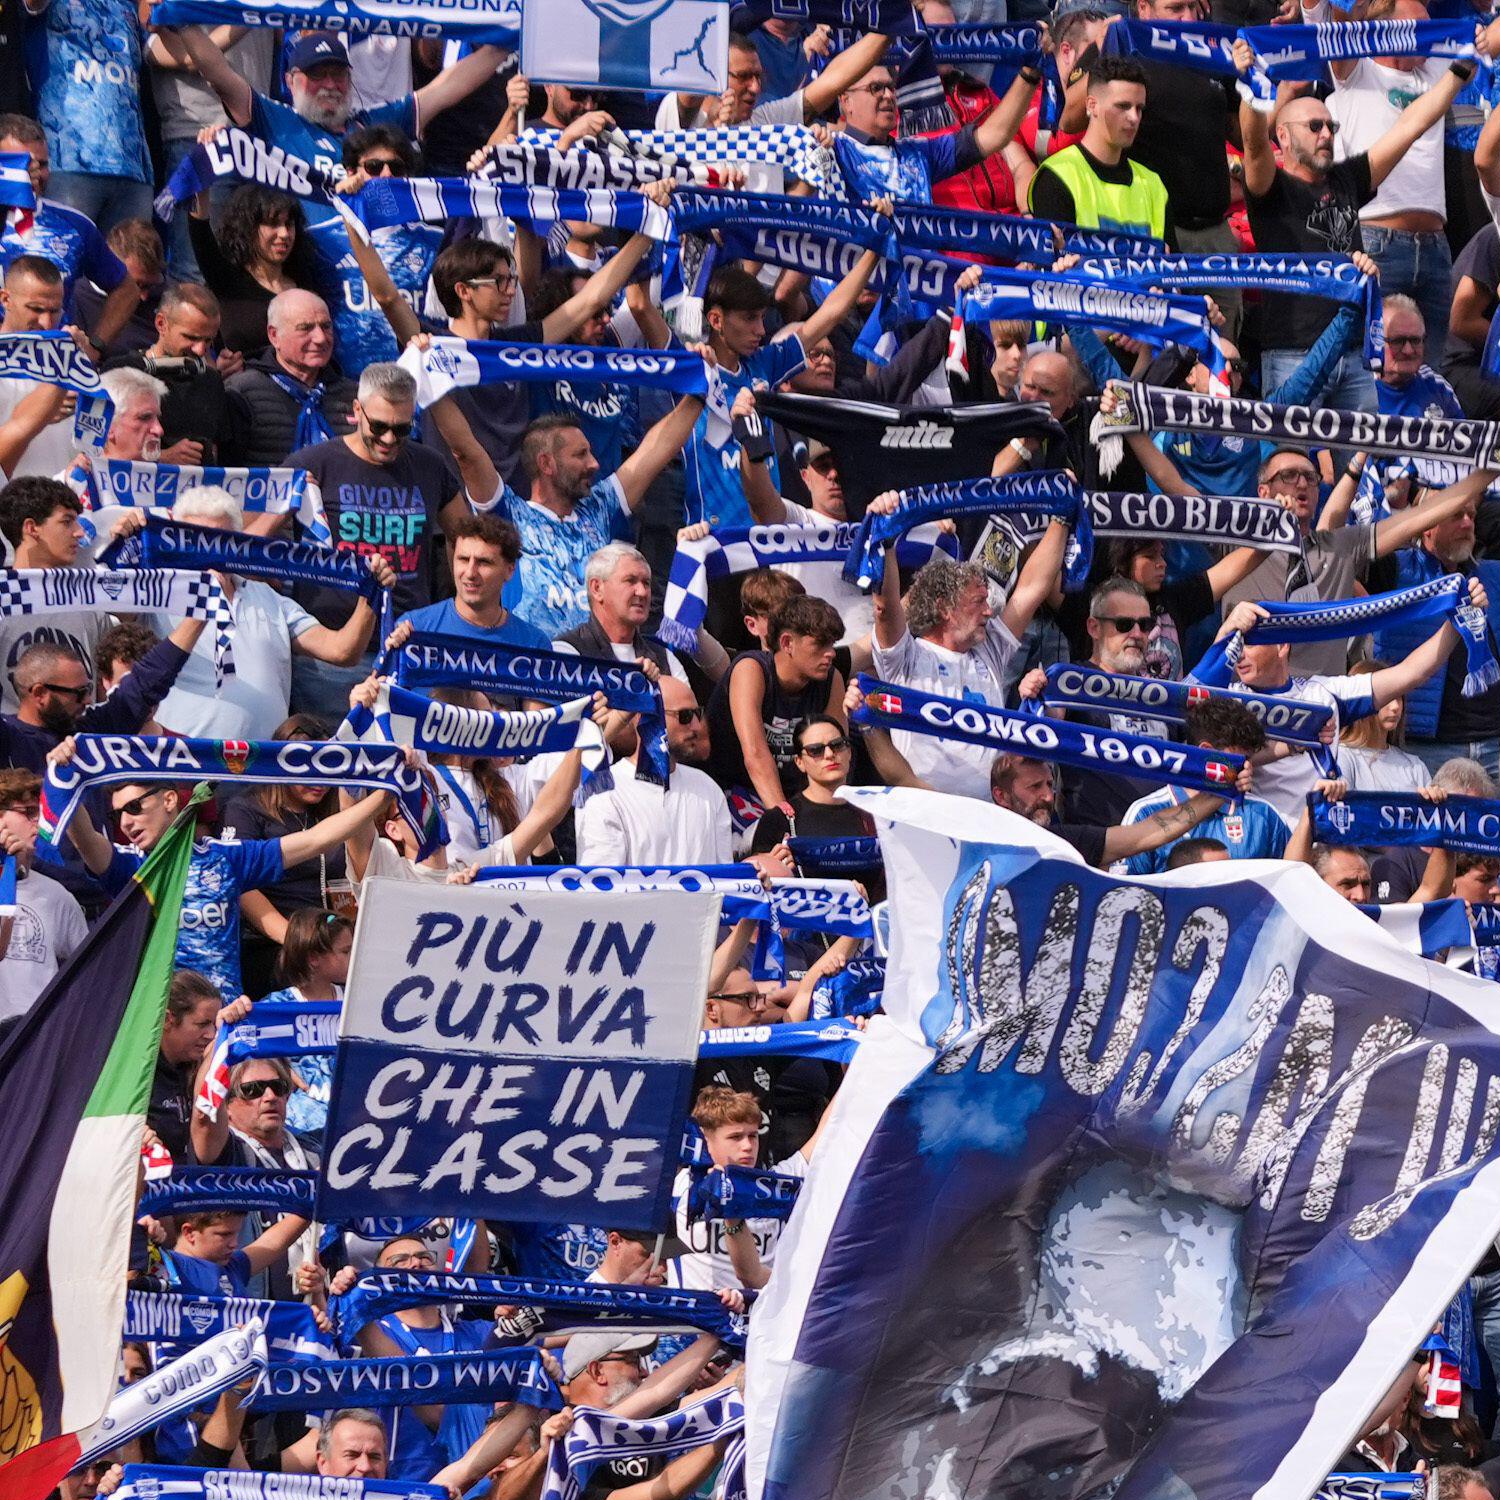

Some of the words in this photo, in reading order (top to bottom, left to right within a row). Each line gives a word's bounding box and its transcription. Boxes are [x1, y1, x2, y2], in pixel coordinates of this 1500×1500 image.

[205, 128, 312, 195] COMO
[1031, 282, 1082, 313] SEMM
[1081, 288, 1168, 325] CUMASCH
[500, 347, 594, 370] COMO
[606, 353, 676, 375] 1907
[882, 420, 953, 449] mita
[1168, 394, 1269, 437] LET'S
[1283, 405, 1340, 440] GO
[1357, 411, 1474, 454] BLUES
[339, 485, 424, 509] GIVOVA
[1120, 492, 1174, 527] GO
[1181, 497, 1296, 541] BLUES
[159, 525, 252, 556] SEMM
[339, 512, 425, 543] SURF
[748, 524, 833, 553] COMO
[405, 644, 500, 675] SEMM
[1056, 670, 1168, 704] COMO
[421, 702, 492, 745] COMO
[500, 710, 552, 746] 1907
[919, 700, 1059, 748] COMO
[1079, 733, 1187, 773] 1907
[48, 736, 201, 787] CURVA
[276, 741, 422, 791] COMO
[1379, 805, 1467, 833] SEMM
[406, 903, 542, 973] PIÙ
[566, 921, 655, 977] IN
[380, 975, 653, 1048] CURVA
[365, 1058, 535, 1124] CHE
[549, 1068, 645, 1130] IN
[327, 1124, 662, 1201] CLASSE
[609, 1459, 650, 1478] 1907
